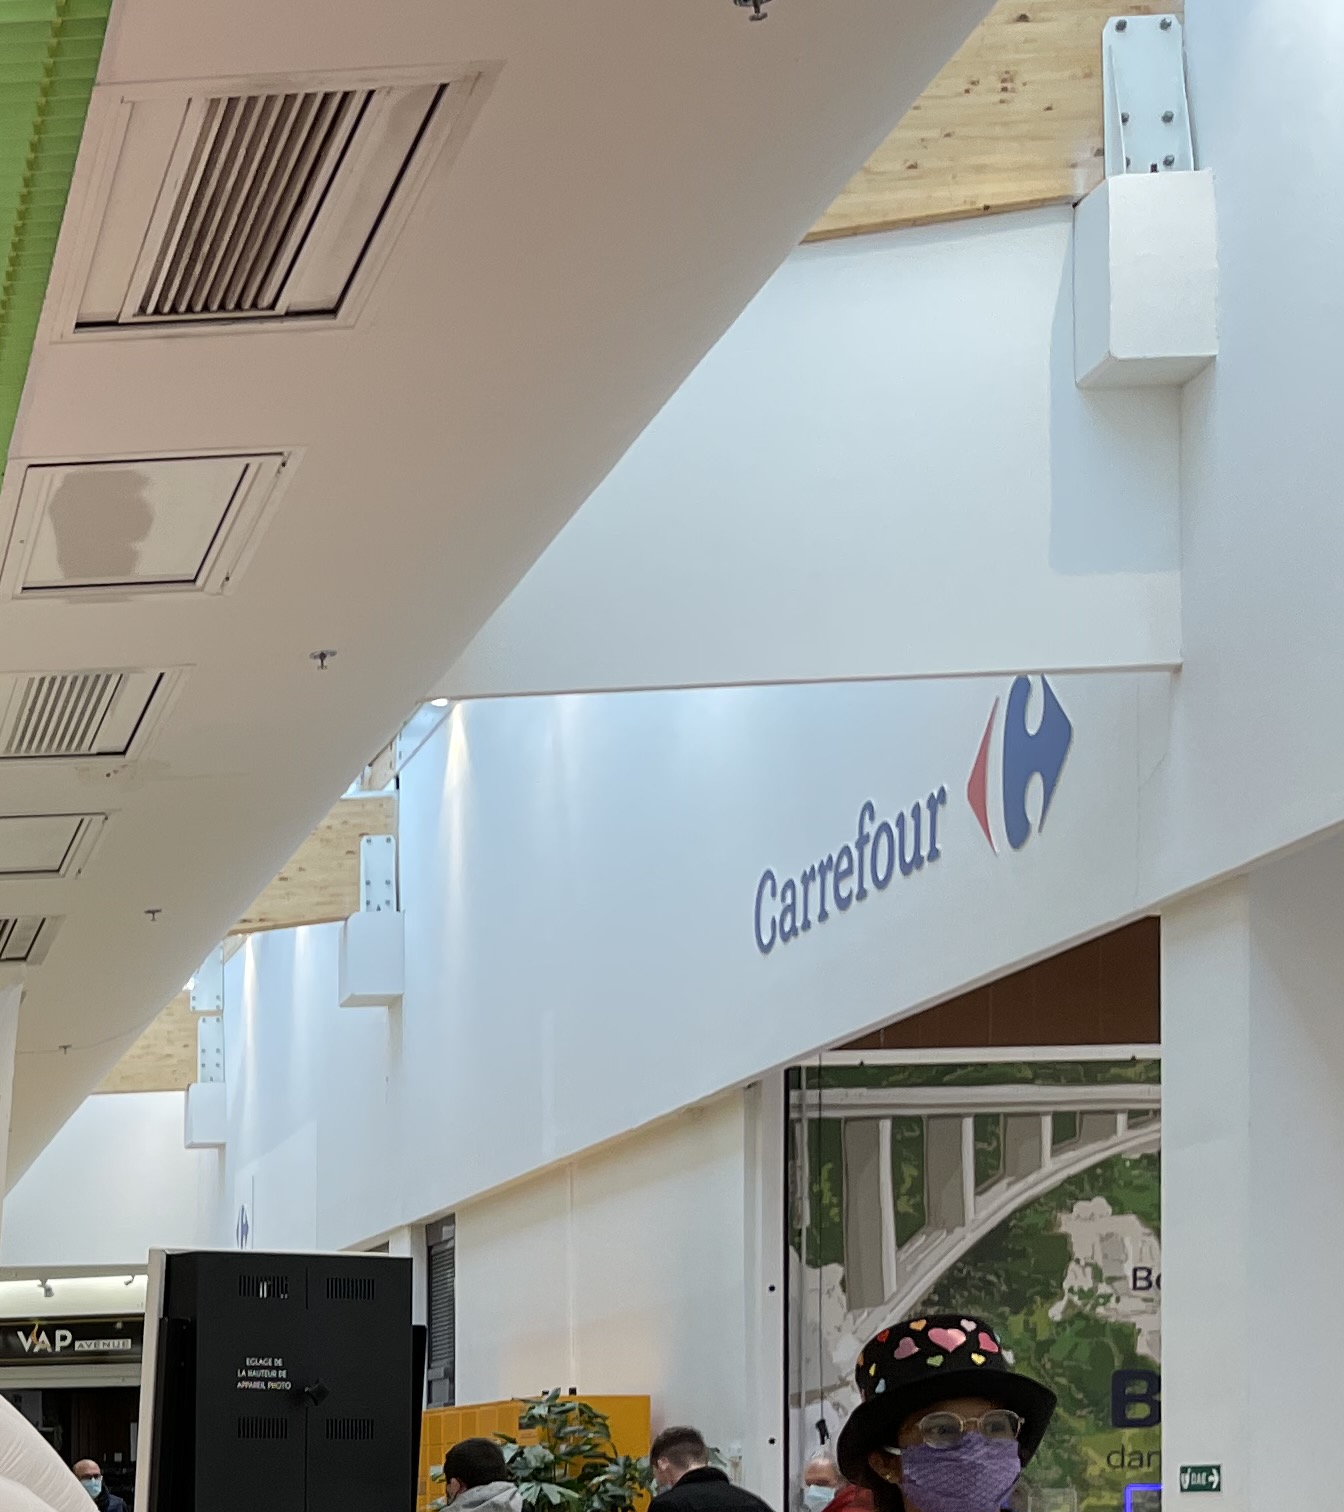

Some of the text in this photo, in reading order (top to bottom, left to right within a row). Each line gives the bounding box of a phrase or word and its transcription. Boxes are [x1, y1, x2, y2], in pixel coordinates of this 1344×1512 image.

[754, 785, 947, 954] Carrefour
[17, 1328, 131, 1353] VAP AVENUE
[237, 1369, 246, 1378] LA
[268, 1381, 291, 1389] PHOTO
